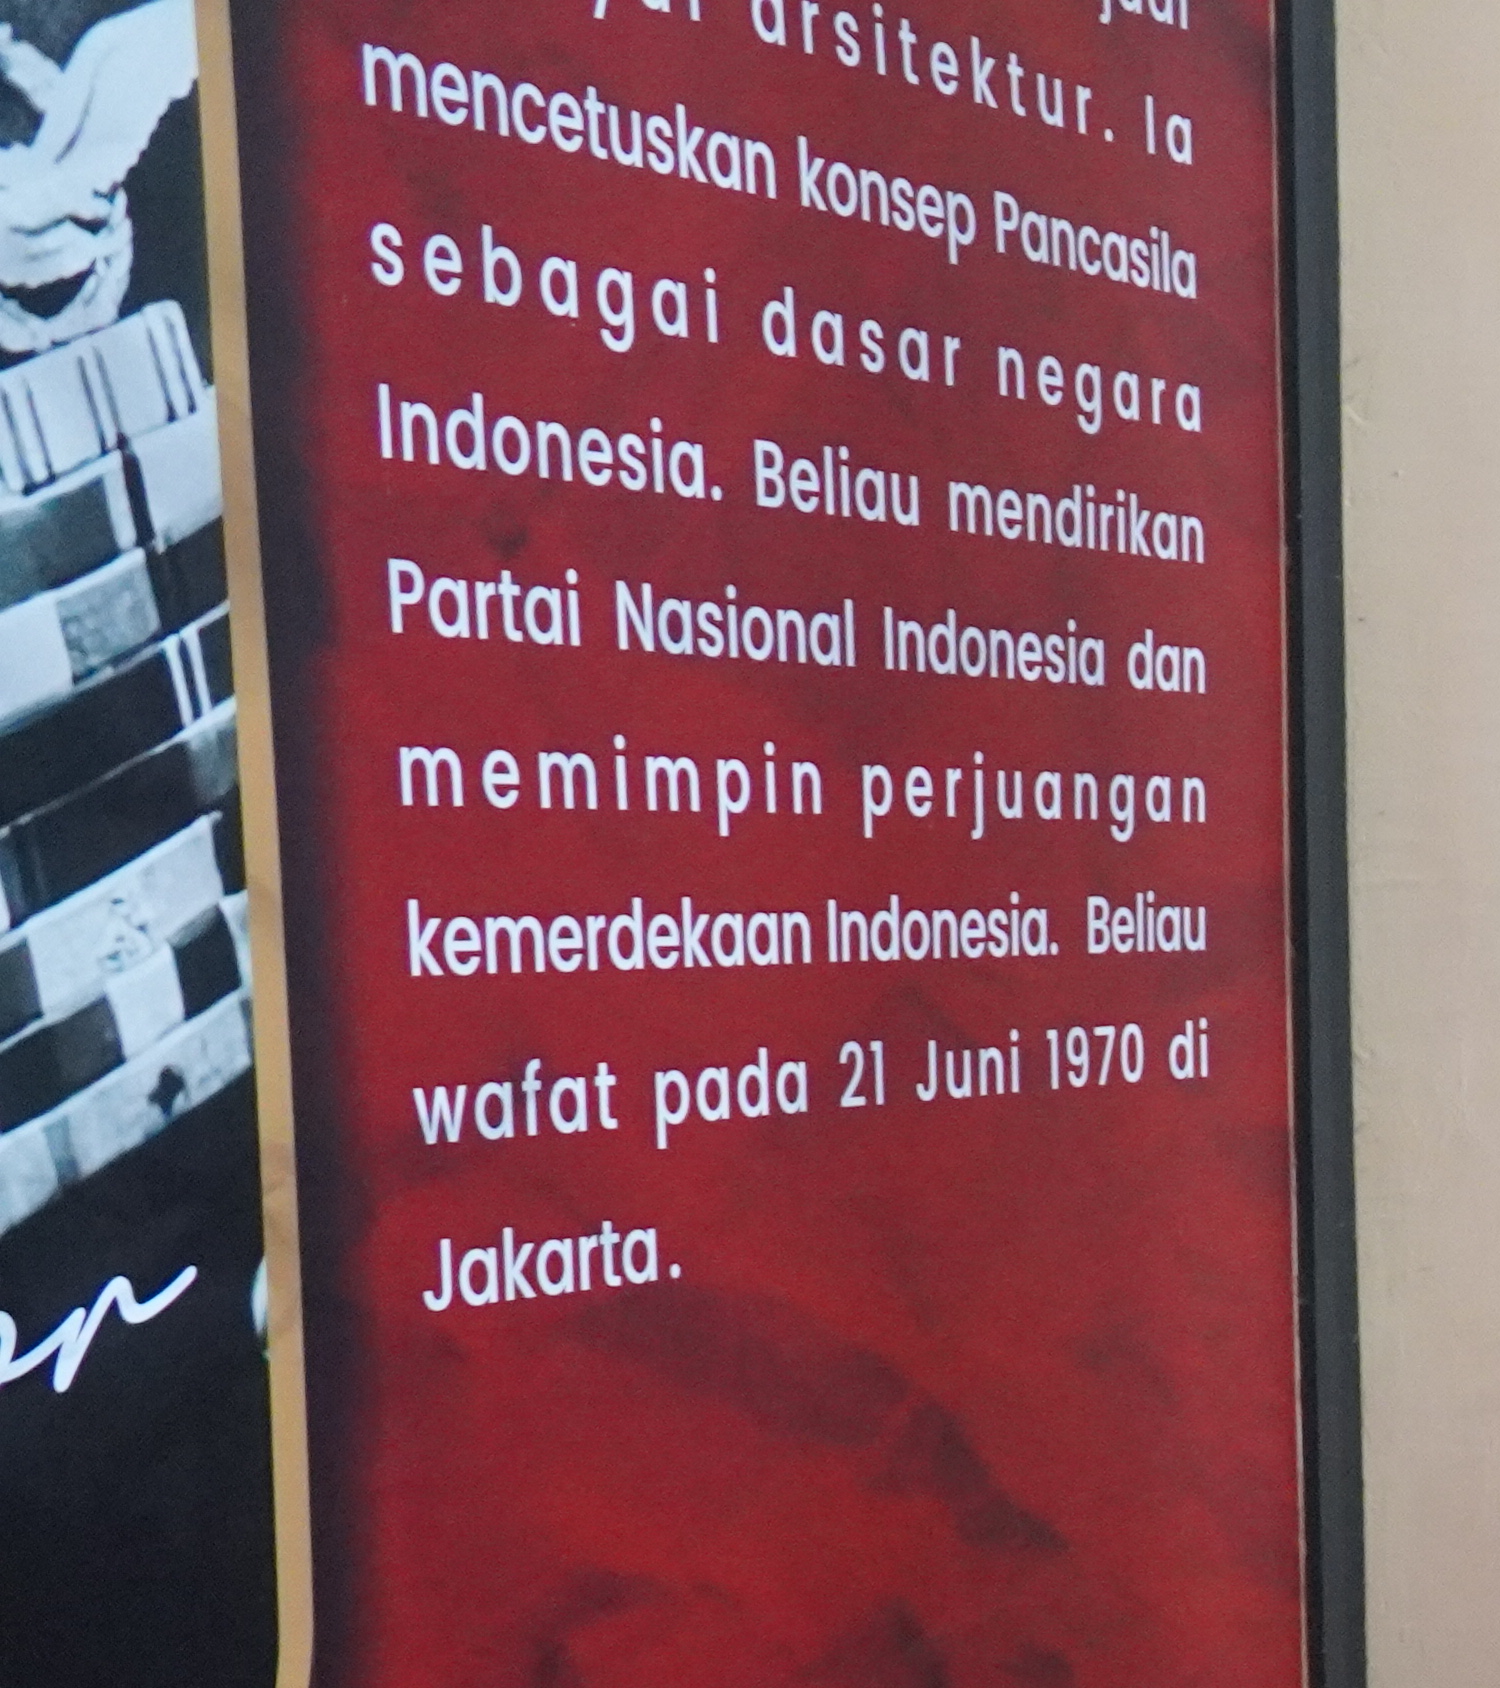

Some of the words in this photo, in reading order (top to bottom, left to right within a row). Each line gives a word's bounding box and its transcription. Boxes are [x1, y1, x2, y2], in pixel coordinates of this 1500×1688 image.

[752, 0, 1113, 144] arsitektur.
[1146, 95, 1193, 165] Ia
[362, 44, 777, 200] mencetuskan
[797, 136, 976, 265] konsep
[993, 191, 1197, 300] Pancasila
[371, 223, 718, 353] sebagai
[762, 287, 961, 386] dasar
[998, 347, 1201, 435] negara
[379, 384, 723, 501] Indonesia.
[753, 439, 920, 526] Beliau
[948, 481, 1205, 564] mendirikan
[387, 558, 581, 647] Partai
[615, 580, 855, 667] Nasional
[883, 606, 1105, 686] Indonesia
[1128, 628, 1206, 694] dan
[399, 734, 822, 837] memimpin
[862, 751, 1206, 843] perjuangan
[407, 896, 812, 977] kemerdekaan
[827, 892, 1059, 963] Indonesia.
[1087, 890, 1206, 954] Beliau
[412, 1058, 618, 1145] wafat
[654, 1047, 808, 1150] pada
[839, 1040, 885, 1111] 21
[916, 1028, 1020, 1102] Juni
[1046, 1023, 1144, 1090] 1970
[1168, 1017, 1209, 1080] di
[423, 1220, 682, 1312] Jakarta.
